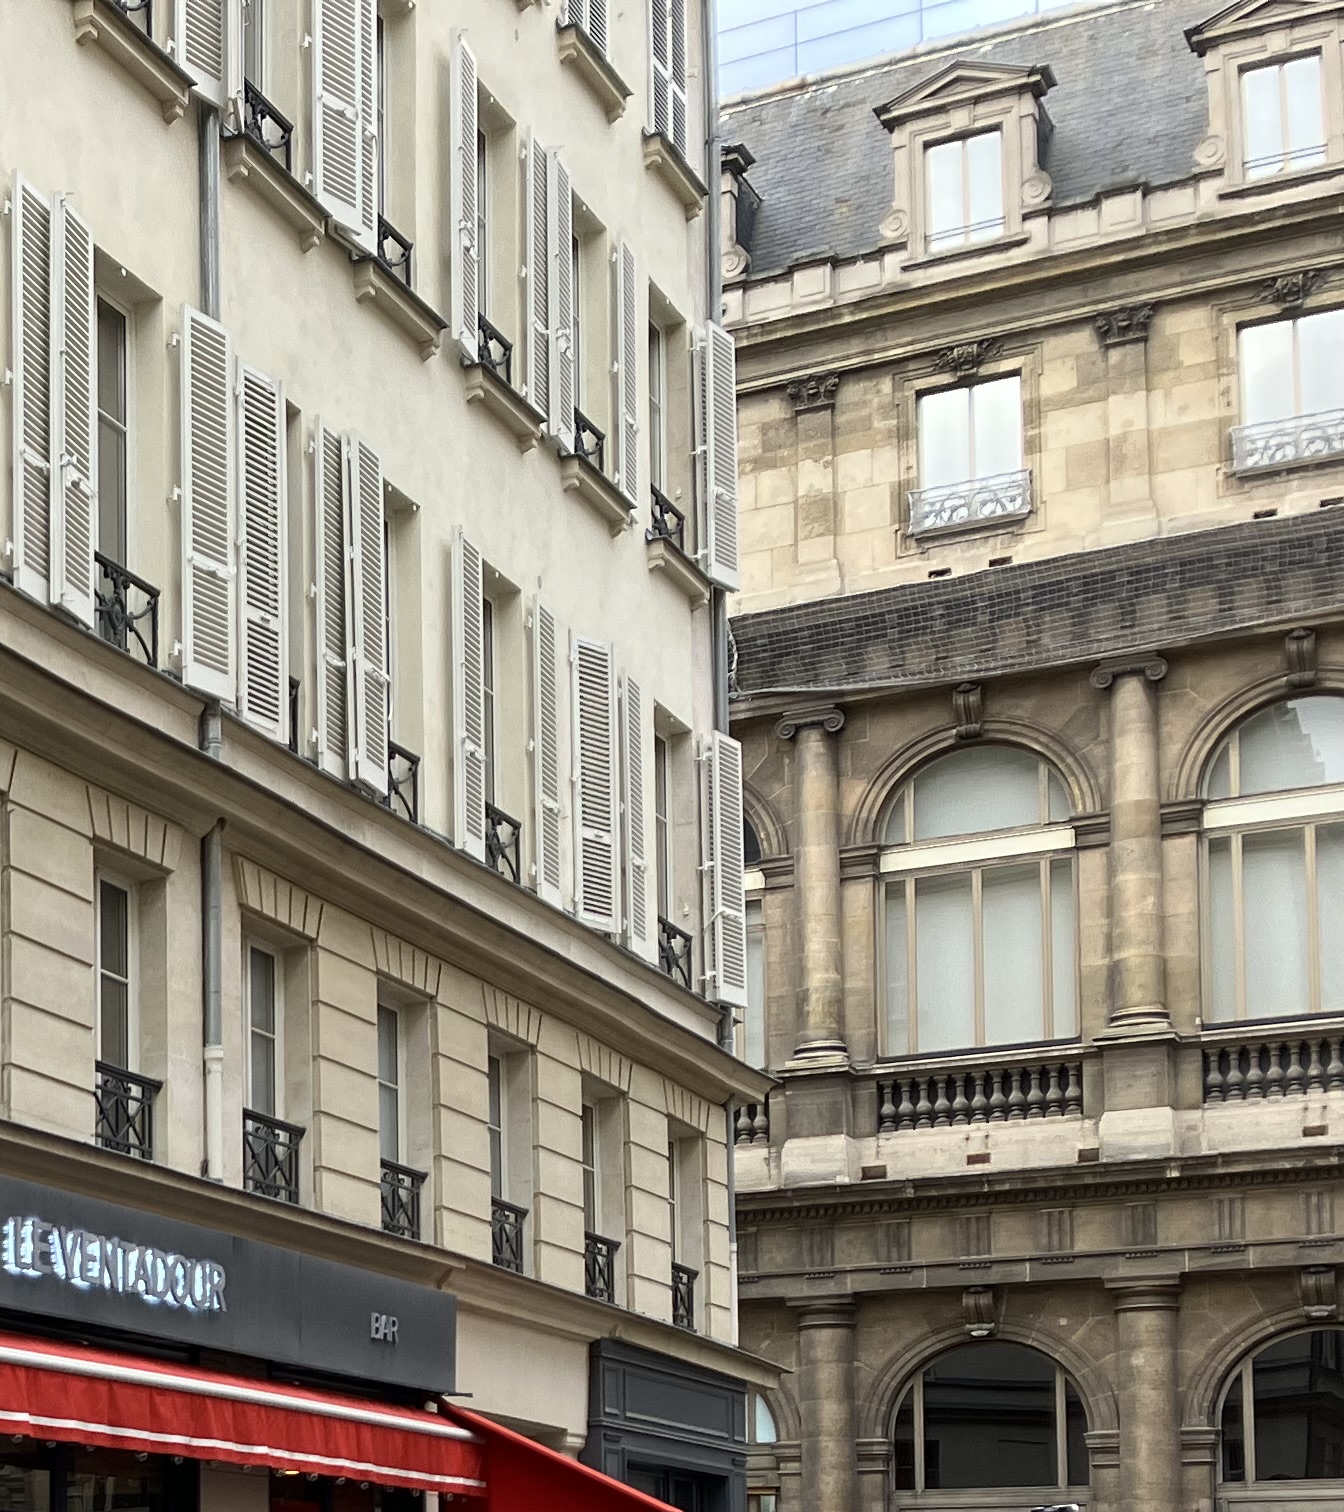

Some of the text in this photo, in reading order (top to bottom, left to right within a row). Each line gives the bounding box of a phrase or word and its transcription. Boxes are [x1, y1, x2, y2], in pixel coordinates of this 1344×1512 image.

[3, 1216, 228, 1313] LE VENTADOUR
[370, 1312, 399, 1345] BAR
